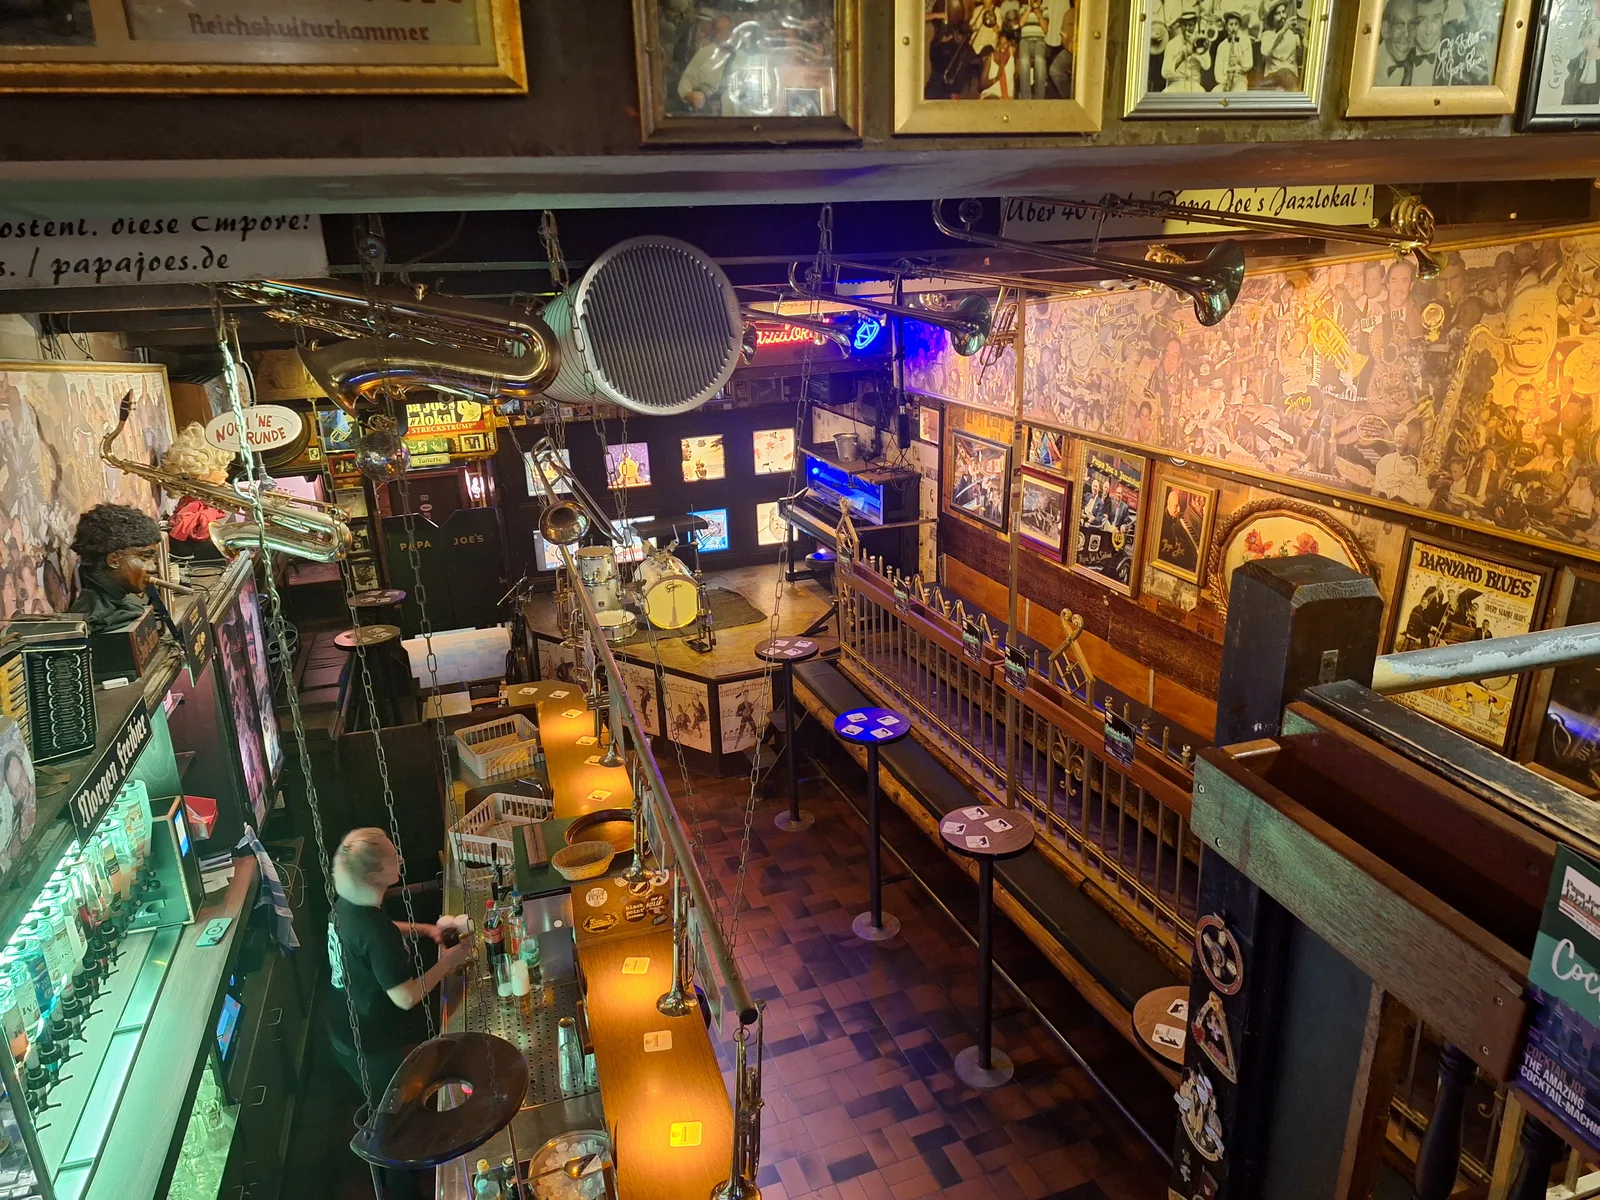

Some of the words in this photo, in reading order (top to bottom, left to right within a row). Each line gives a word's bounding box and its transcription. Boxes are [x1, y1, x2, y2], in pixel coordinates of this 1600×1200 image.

[188, 12, 430, 42] Reichskulturkammer
[1061, 206, 1087, 221] 40
[1216, 187, 1266, 214] Joe's
[1268, 185, 1358, 217] Jazzlokal
[50, 245, 230, 285] papajoes.de
[246, 426, 287, 446] RUNDE
[400, 540, 432, 552] PAPA
[453, 533, 485, 546] JOE'S
[77, 761, 119, 828] Morgen
[1552, 937, 1600, 1003] Coc
[1524, 1053, 1543, 1074] THE
[1542, 1068, 1585, 1110] AMAZING
[1526, 1042, 1569, 1083] COCKTAIL
[1569, 1078, 1587, 1096] JOE
